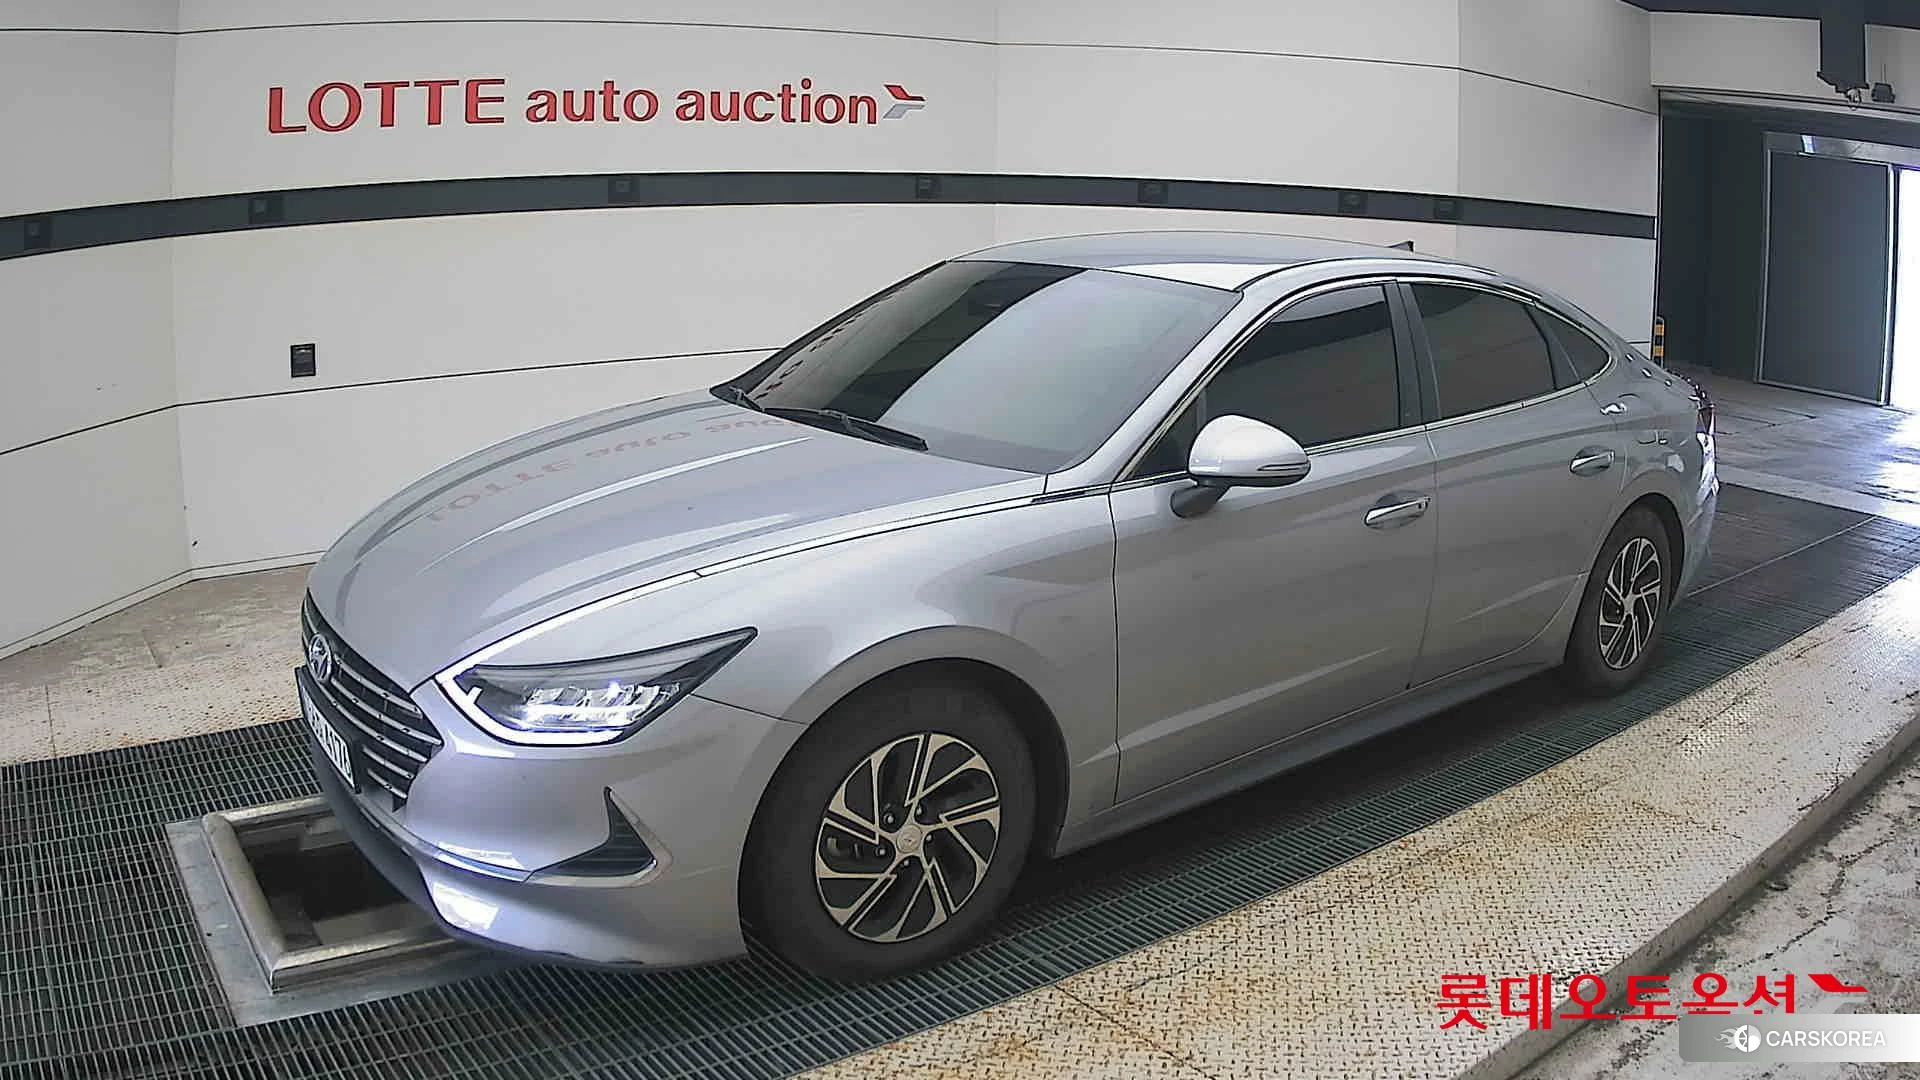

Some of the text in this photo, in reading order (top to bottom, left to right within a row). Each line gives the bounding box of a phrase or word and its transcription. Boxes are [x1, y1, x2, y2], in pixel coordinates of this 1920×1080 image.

[268, 78, 878, 134] LOTTE auto auction
